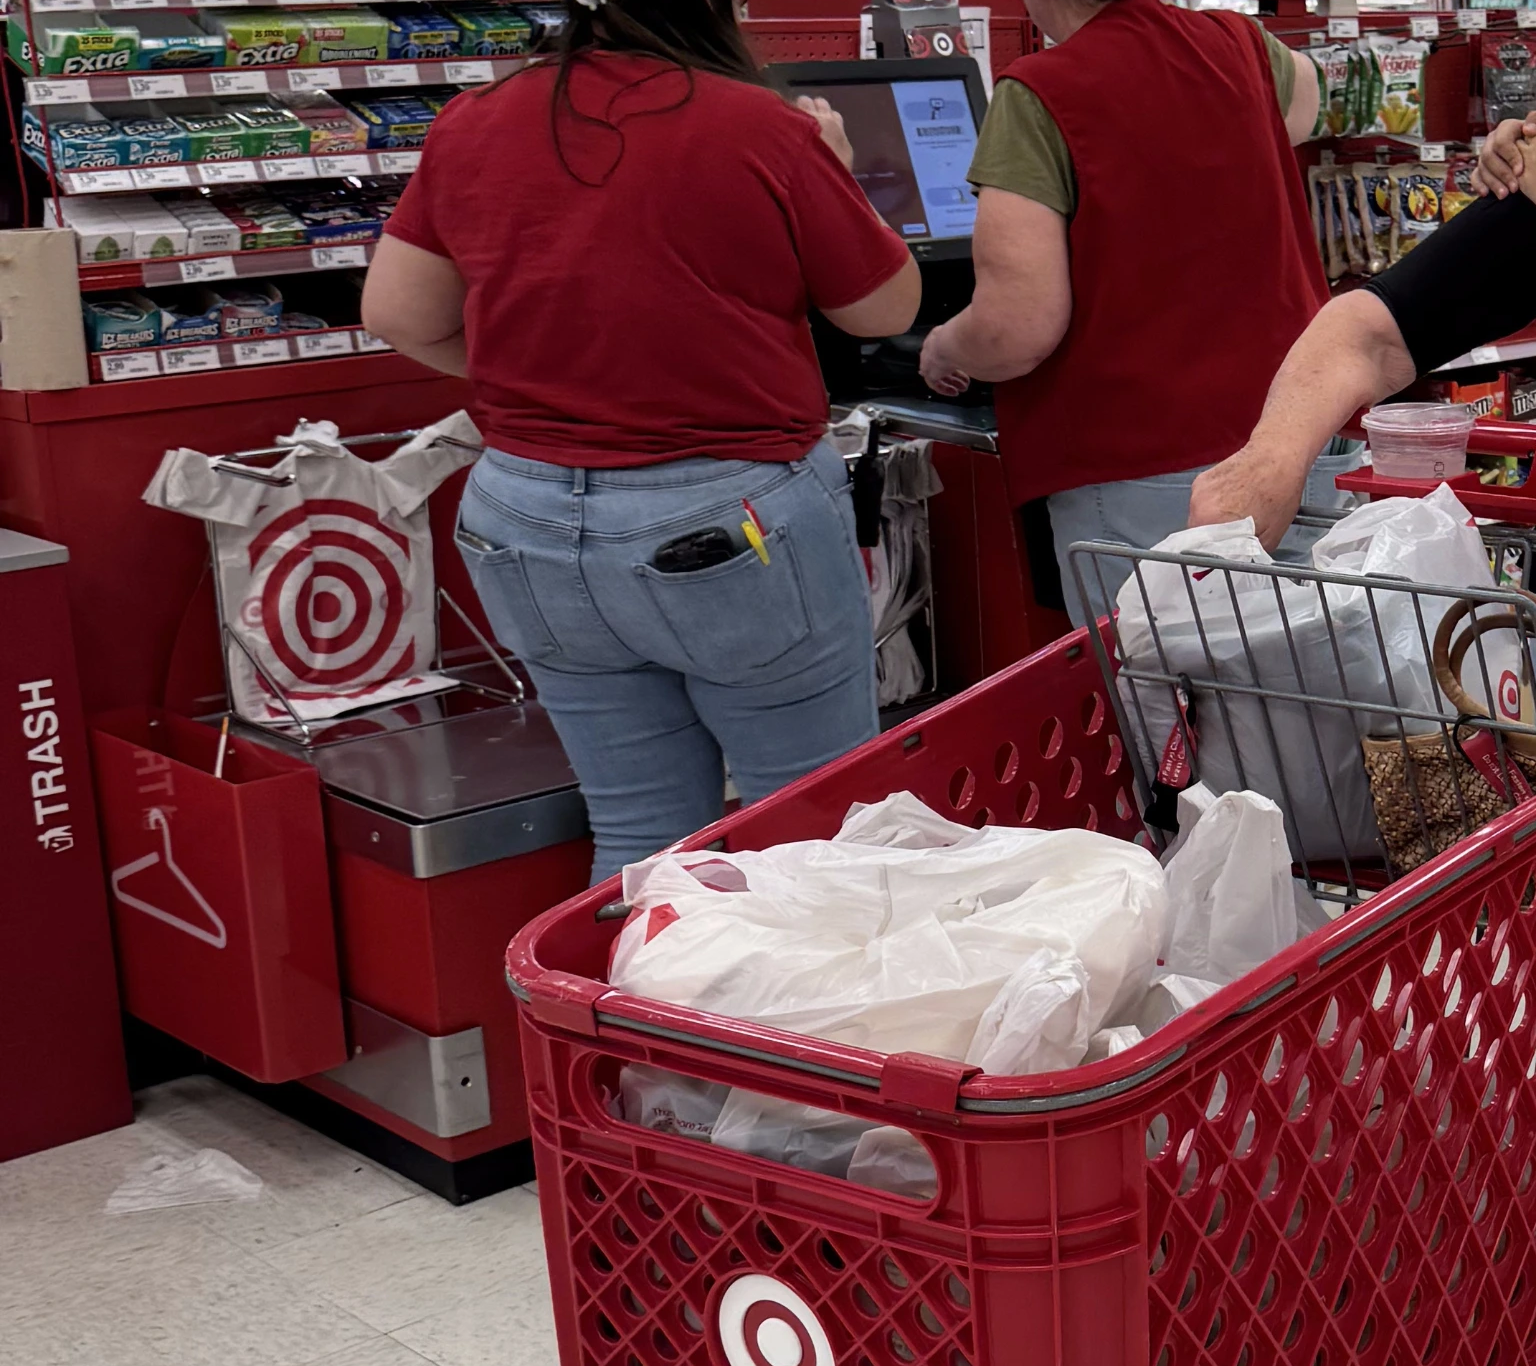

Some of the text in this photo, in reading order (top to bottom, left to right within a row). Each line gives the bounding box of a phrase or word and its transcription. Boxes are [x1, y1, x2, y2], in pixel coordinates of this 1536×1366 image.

[63, 50, 130, 74] Extra
[236, 42, 299, 66] Extra
[59, 124, 111, 138] Extra
[123, 121, 174, 135] Extra
[226, 315, 278, 329] ICE BREAKERS
[19, 678, 69, 826] TRASH
